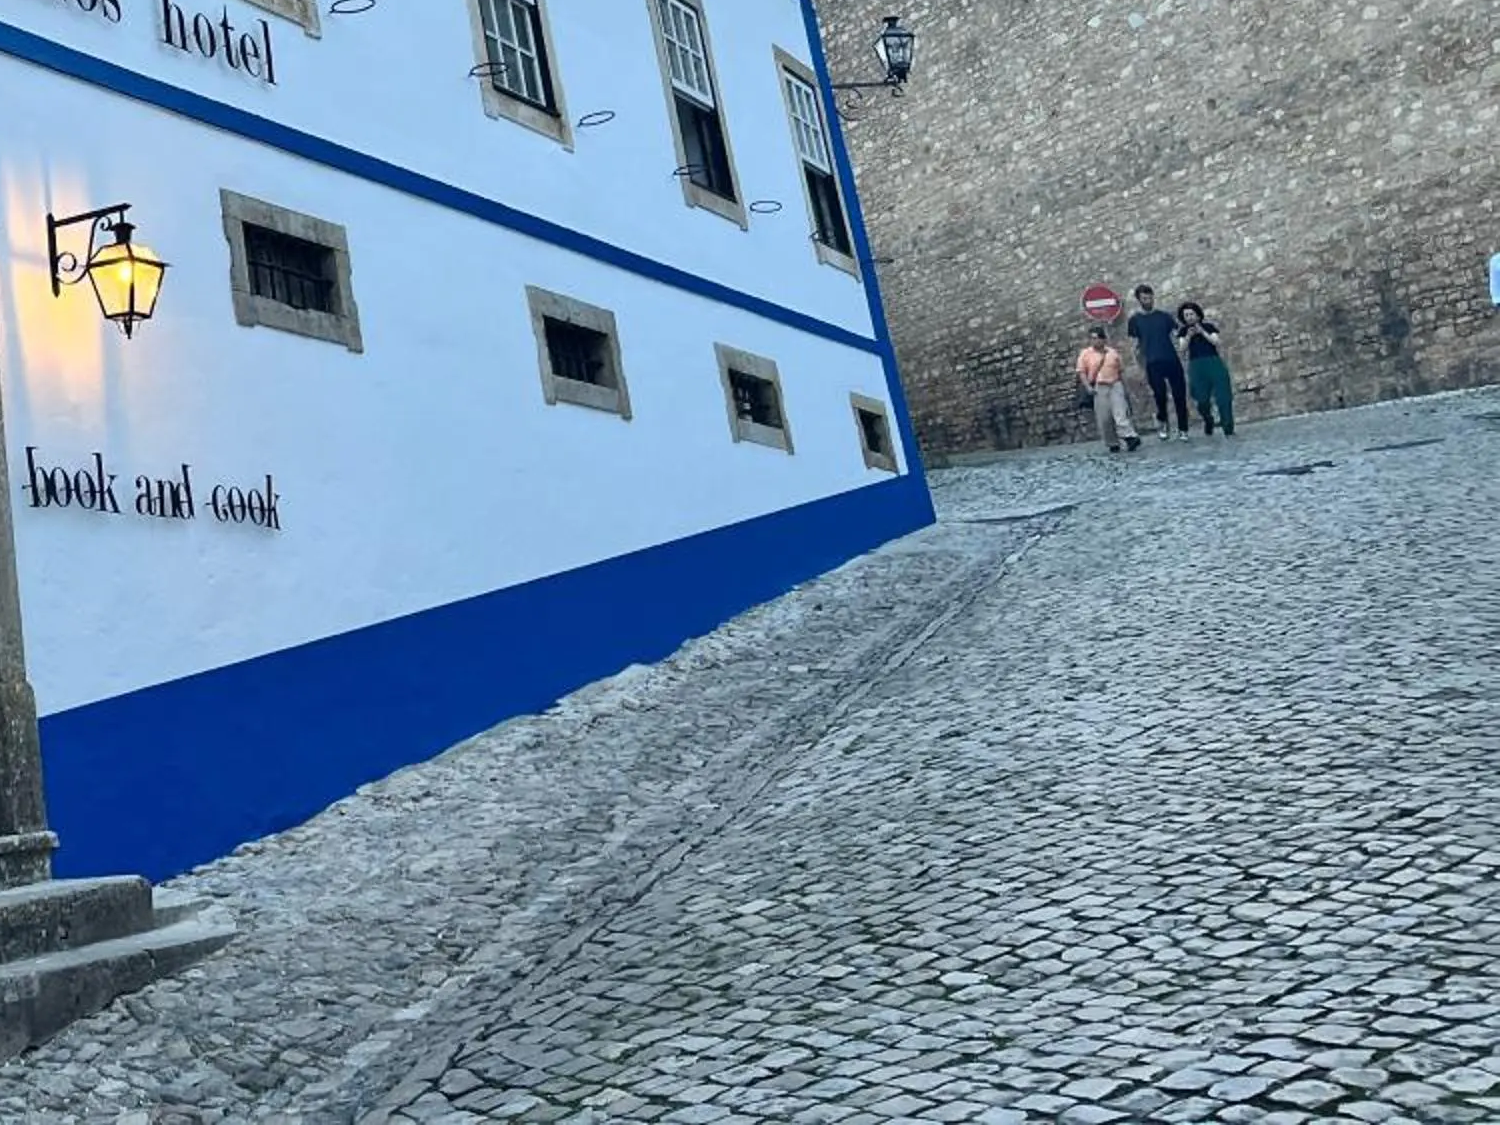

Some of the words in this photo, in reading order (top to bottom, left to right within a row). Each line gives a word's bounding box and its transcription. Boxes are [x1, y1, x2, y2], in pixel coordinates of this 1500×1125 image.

[25, 446, 120, 514] book
[135, 463, 195, 520] and
[211, 474, 282, 530] cook
